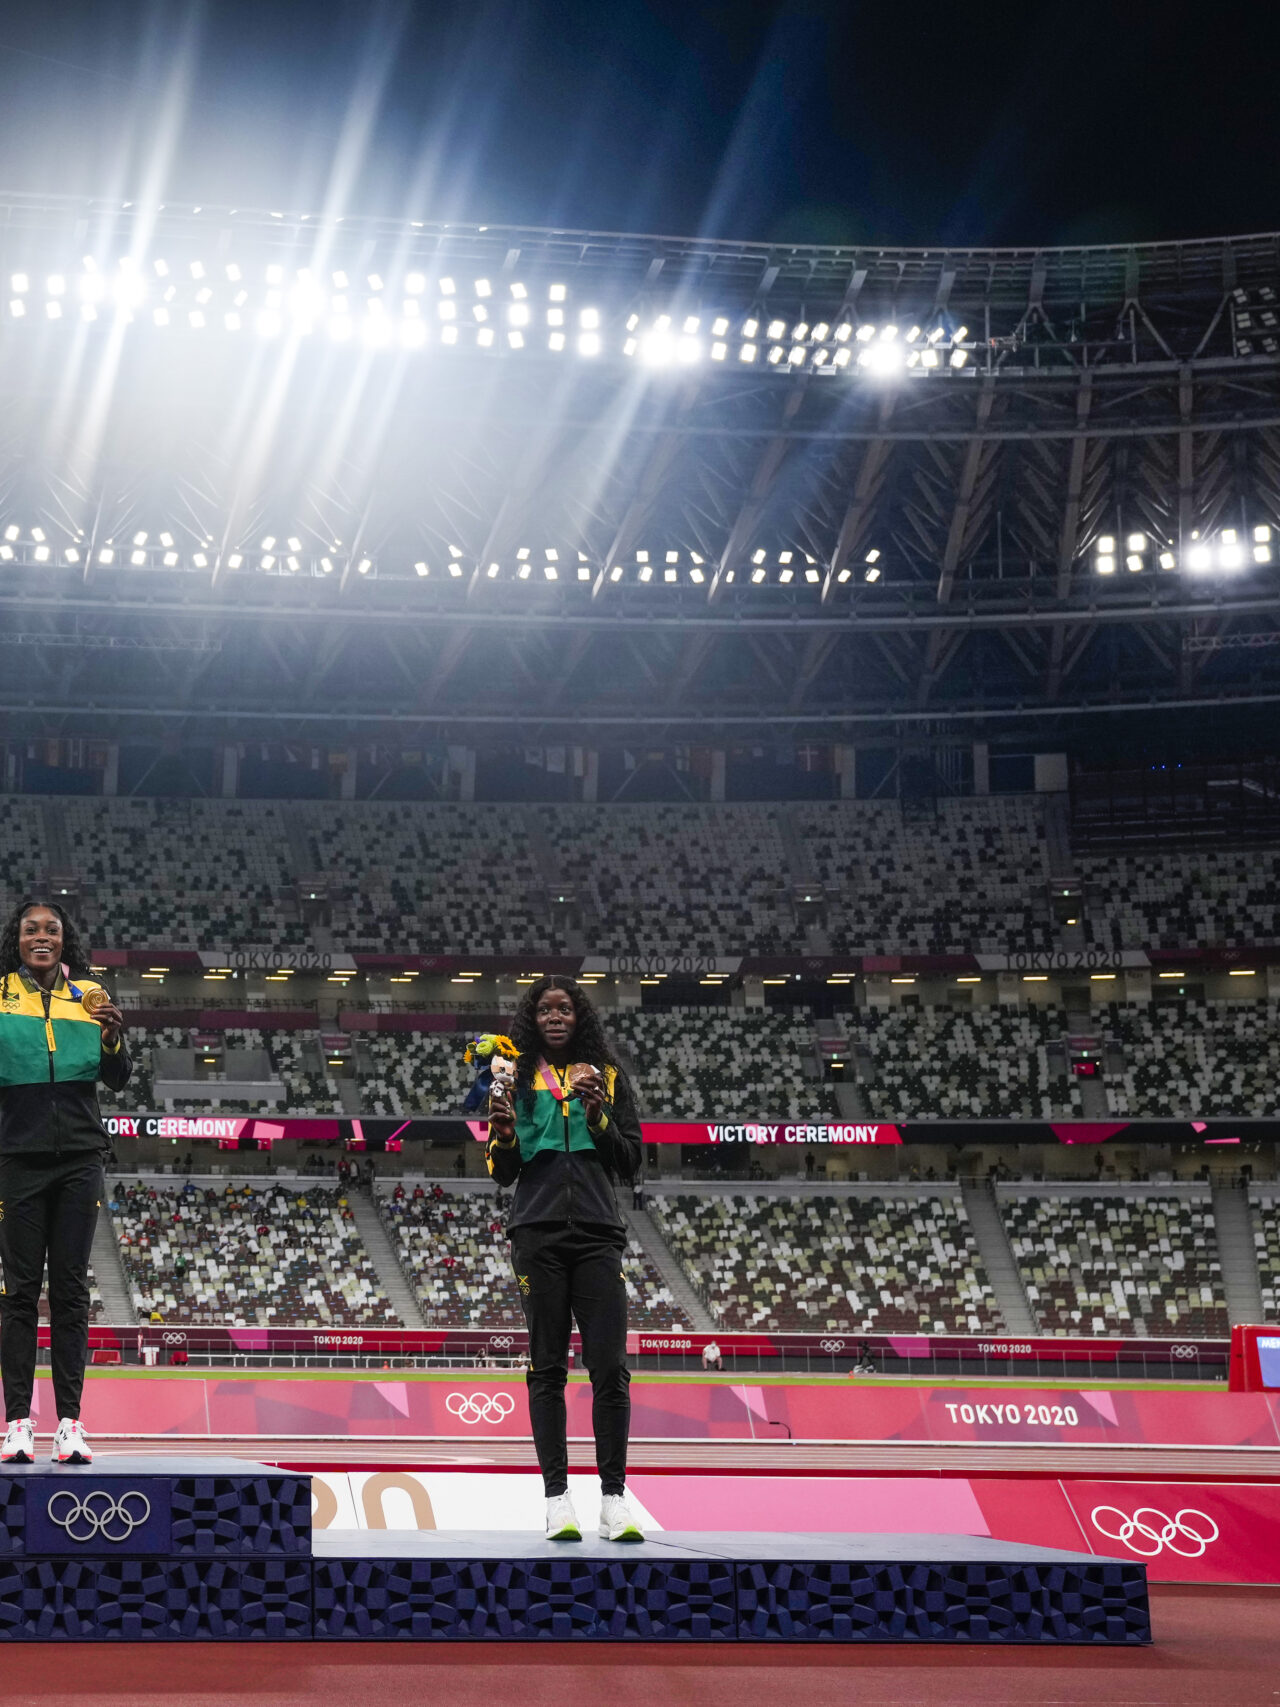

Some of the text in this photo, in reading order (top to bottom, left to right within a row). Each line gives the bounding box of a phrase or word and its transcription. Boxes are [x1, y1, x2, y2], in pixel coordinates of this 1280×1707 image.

[224, 952, 332, 969] TOKYO 2020
[606, 955, 716, 973] TOKYO 2020
[1004, 951, 1122, 971] TOKYO 2020
[146, 1119, 236, 1137] CEREMONY
[707, 1125, 878, 1143] VICTORY CEREMONY
[313, 1335, 363, 1345] TOKYO 2020
[641, 1339, 691, 1349] TOKYO 2020
[977, 1343, 1032, 1353] TOKYO 2020
[945, 1403, 1079, 1426] TOKYO 2020
